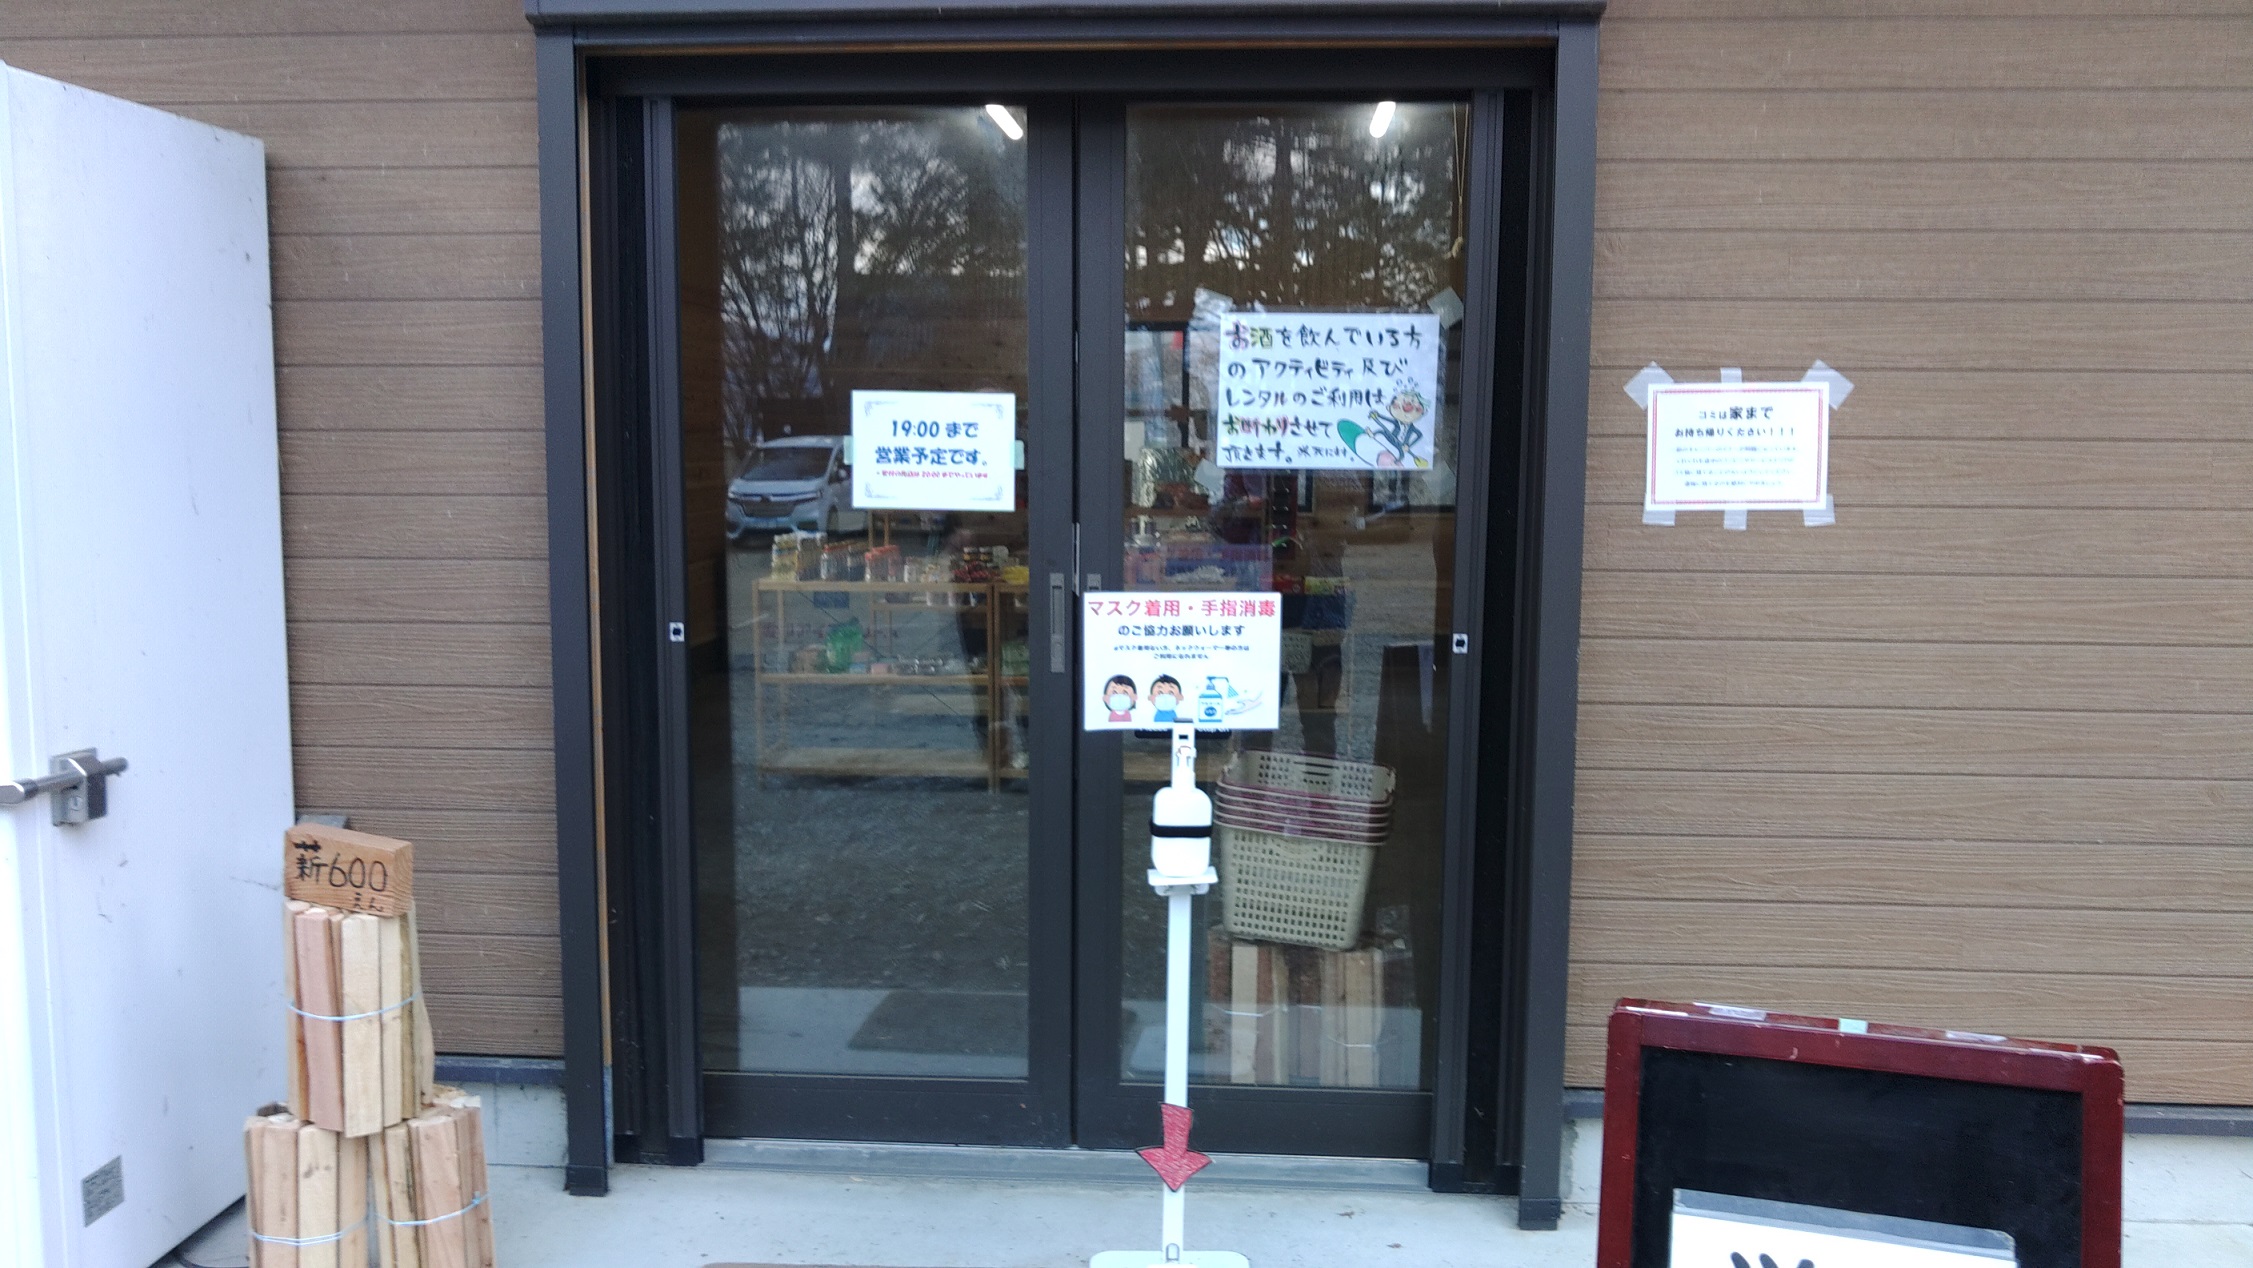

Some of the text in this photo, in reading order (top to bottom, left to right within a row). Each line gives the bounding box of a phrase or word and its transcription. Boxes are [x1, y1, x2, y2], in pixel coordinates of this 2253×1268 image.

[1225, 320, 1422, 351] お酒を飲んでいる方
[891, 419, 979, 438] 19:00 まで
[874, 445, 988, 467] 営業予定です。
[1088, 599, 1276, 618] マスク着用・手指消毒
[1118, 624, 1246, 637] のご協力お願いします
